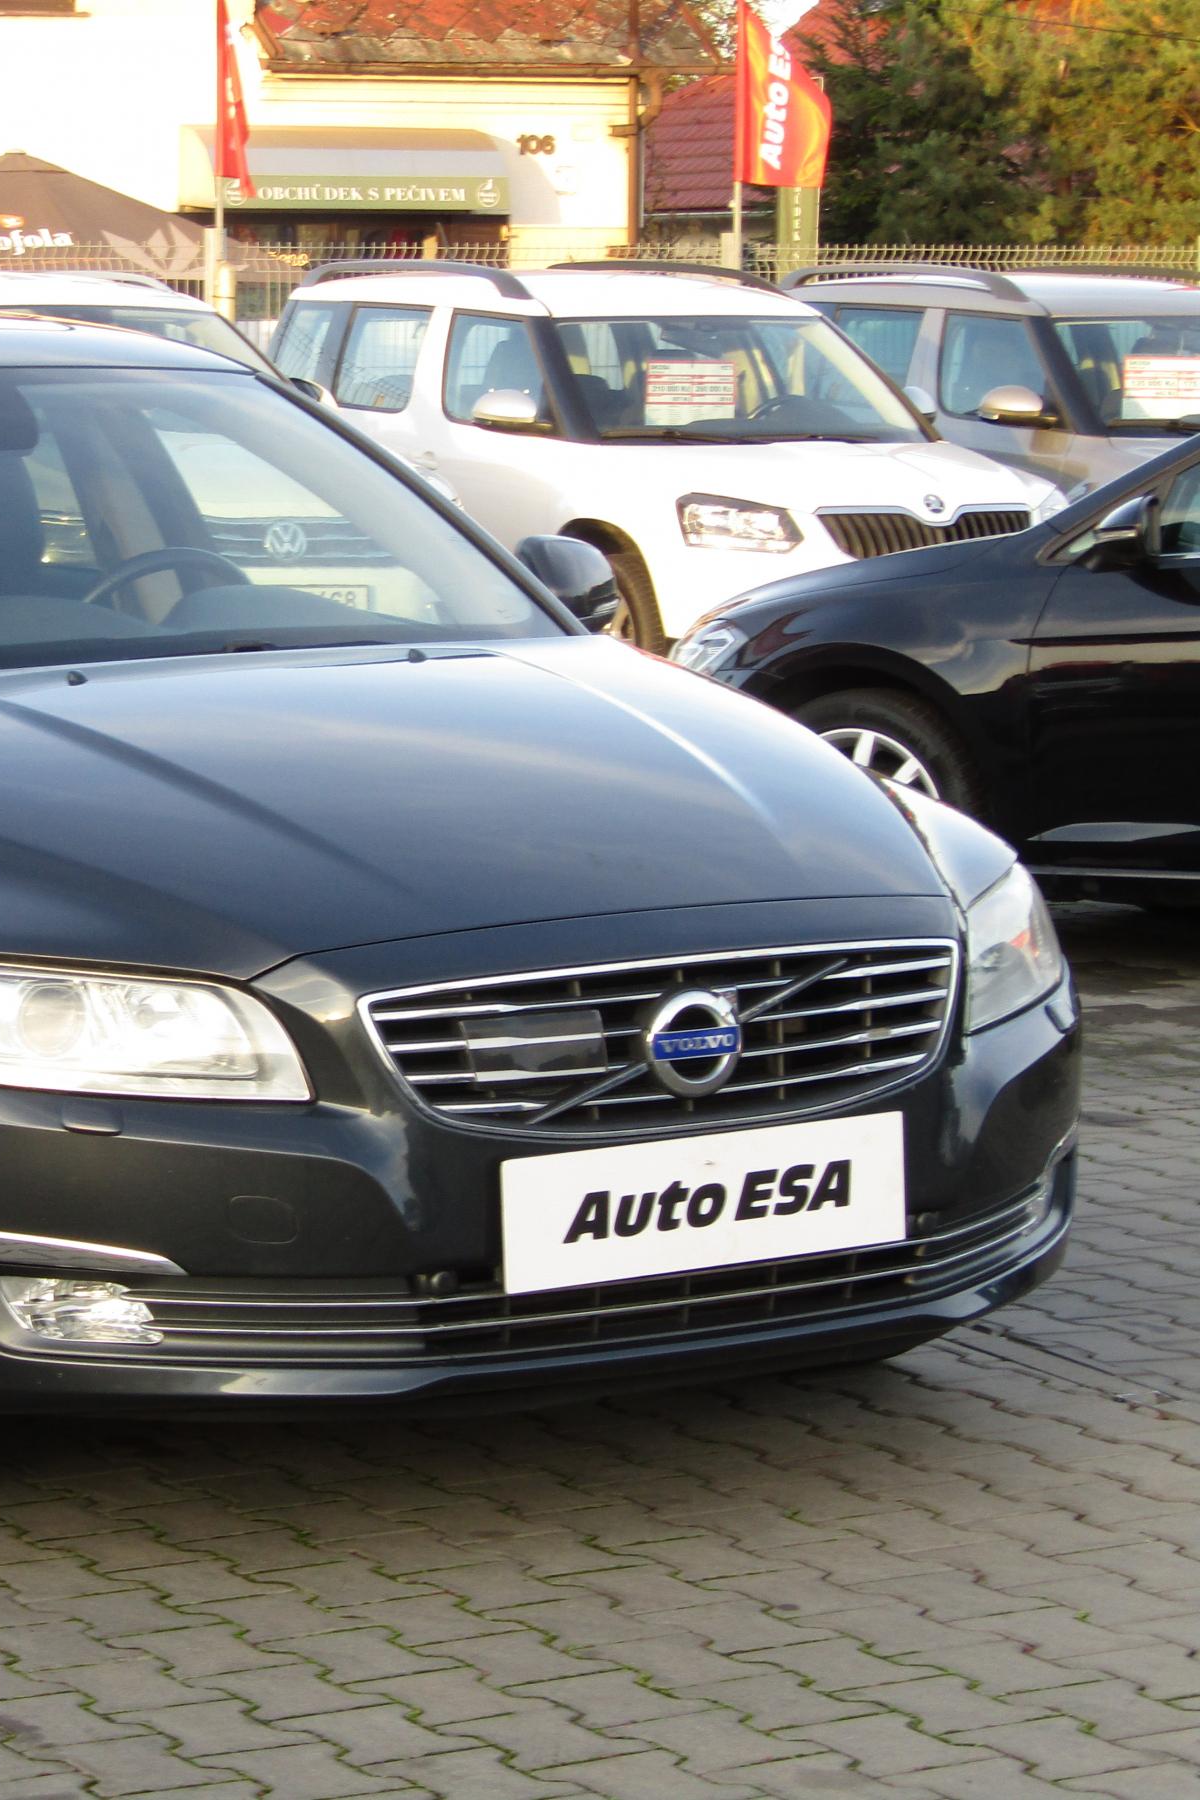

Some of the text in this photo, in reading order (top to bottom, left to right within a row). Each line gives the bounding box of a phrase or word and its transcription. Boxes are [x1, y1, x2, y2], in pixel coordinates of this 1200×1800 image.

[758, 81, 790, 170] Auto
[516, 134, 555, 155] 106
[368, 187, 379, 200] S
[384, 184, 465, 201] PEČIVEM
[658, 1033, 735, 1053] VOLVO
[562, 1159, 852, 1244] Auto ESA
